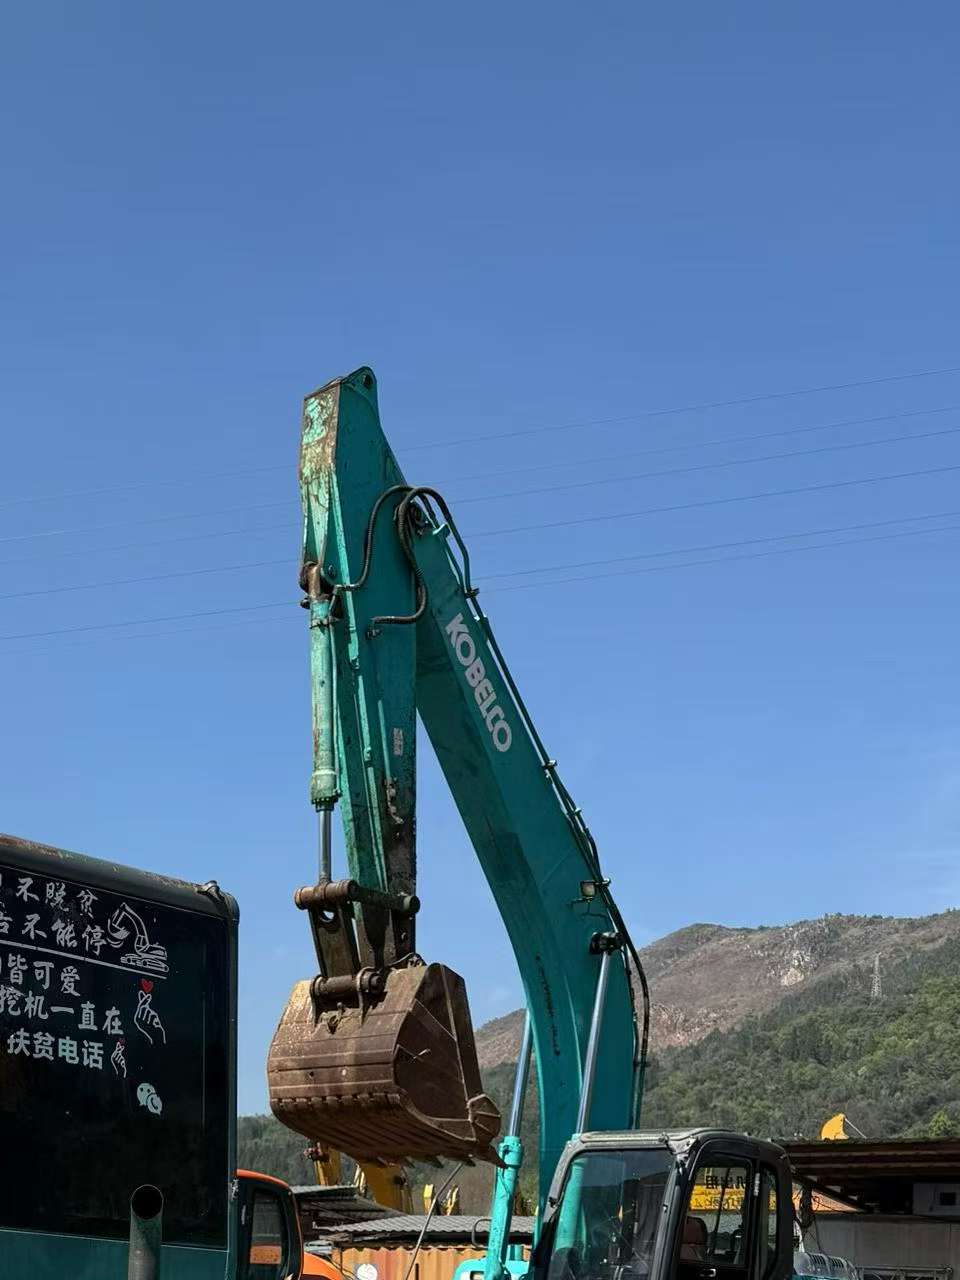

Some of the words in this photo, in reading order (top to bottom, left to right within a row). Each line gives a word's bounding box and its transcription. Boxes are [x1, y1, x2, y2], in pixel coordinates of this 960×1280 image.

[445, 612, 513, 753] KOBELCO
[6, 1028, 104, 1070] 扶贫电话
